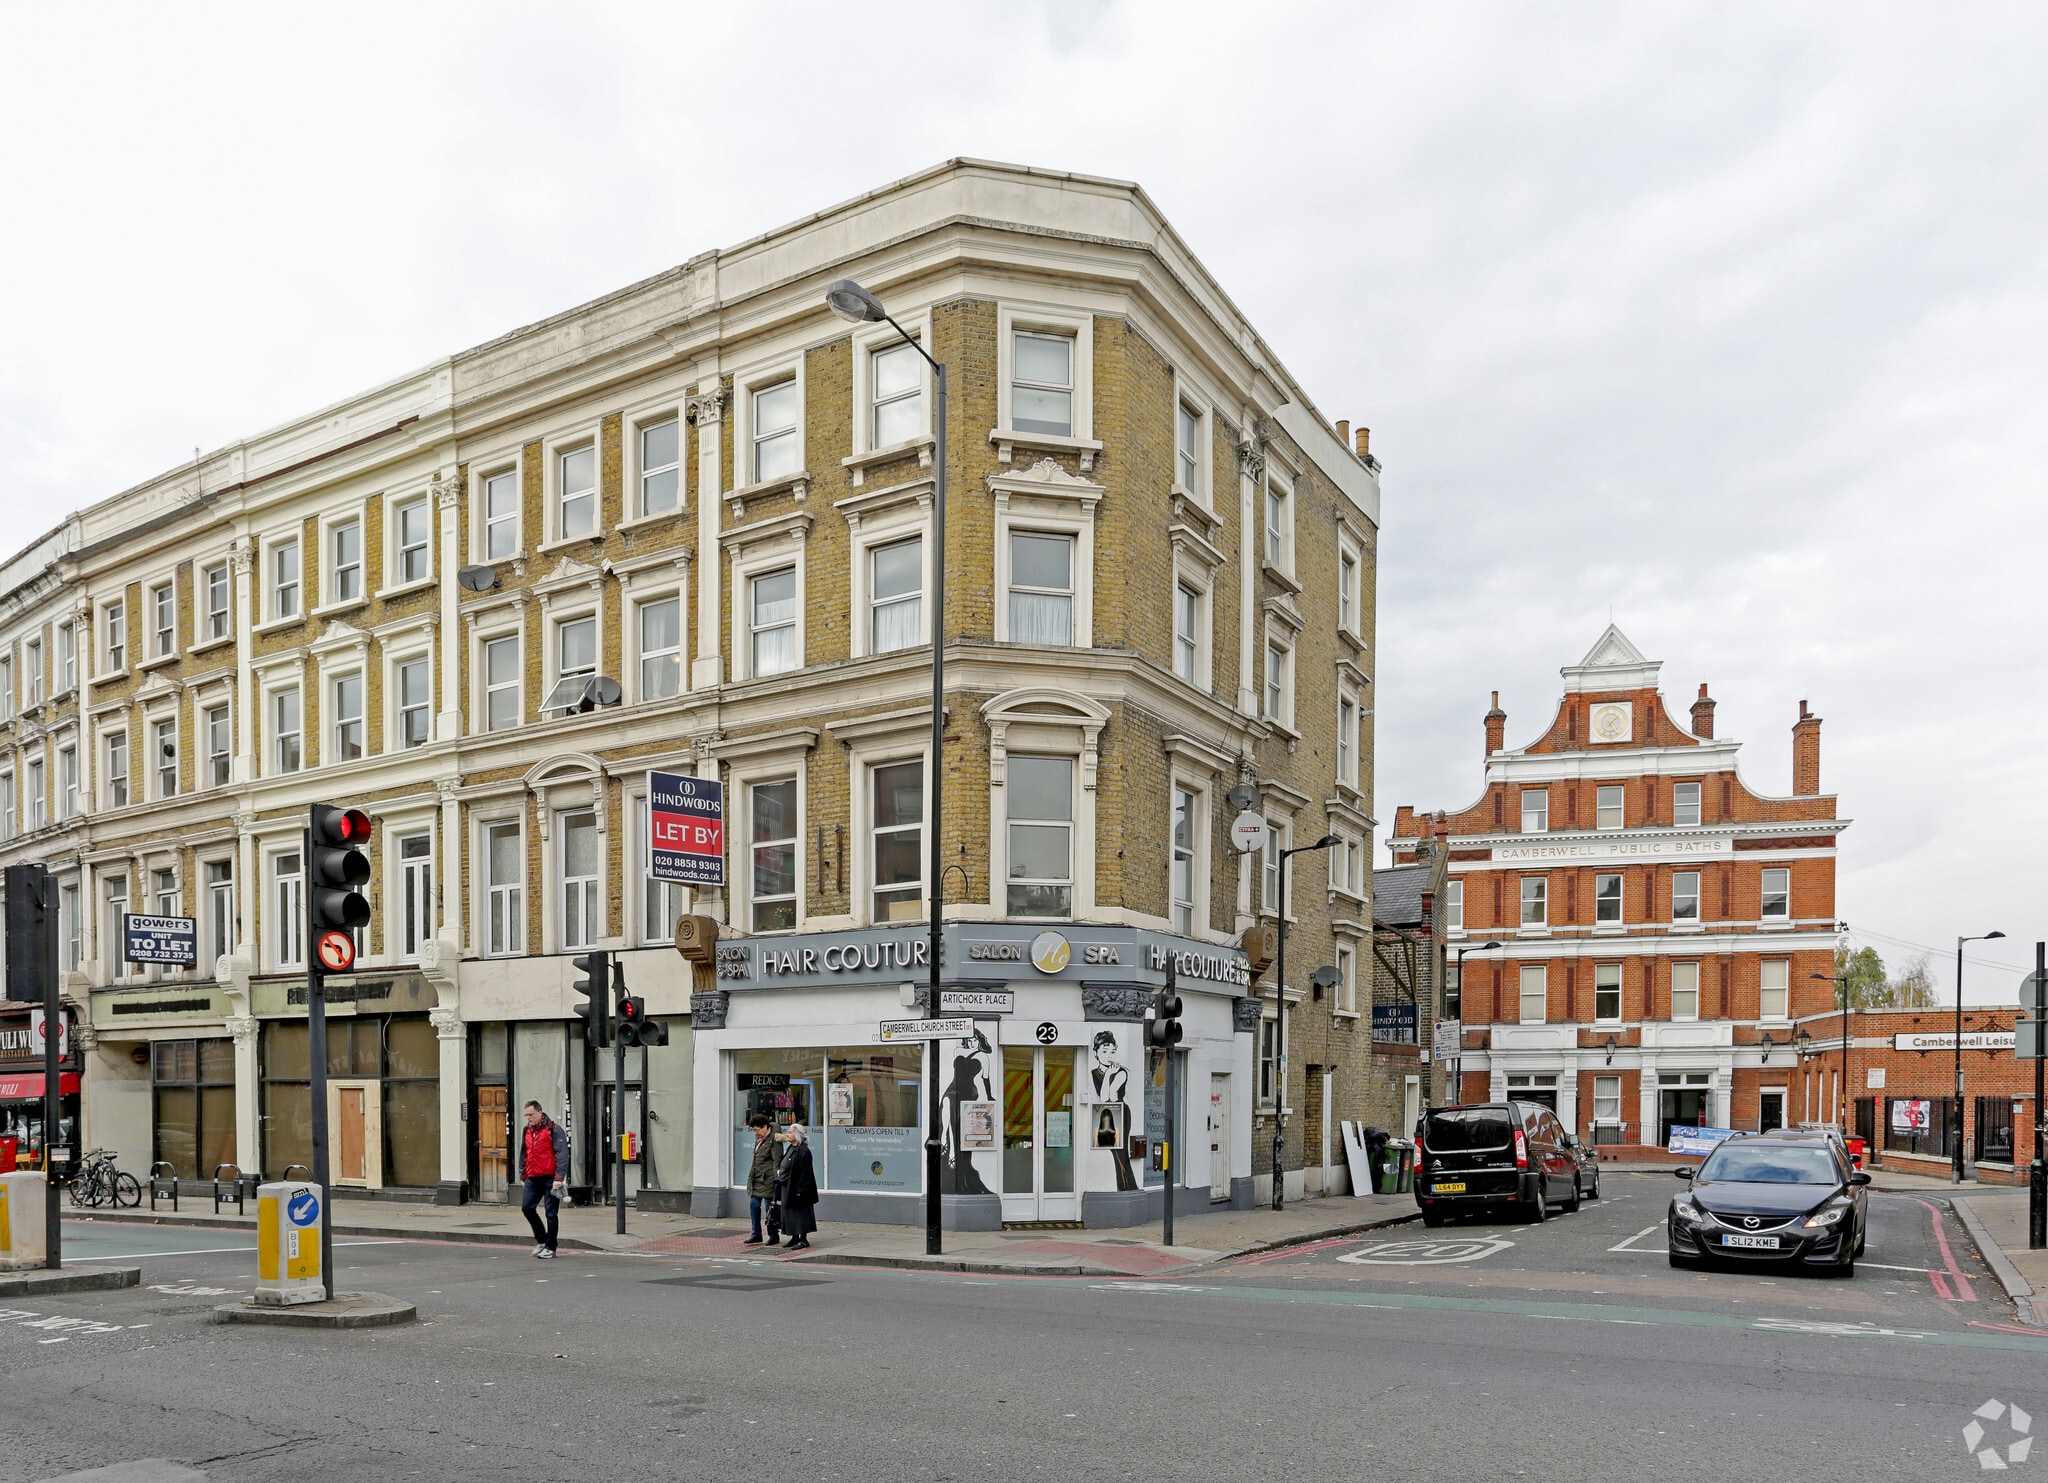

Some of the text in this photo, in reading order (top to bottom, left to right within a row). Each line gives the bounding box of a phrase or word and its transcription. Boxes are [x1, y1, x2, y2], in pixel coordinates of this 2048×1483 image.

[653, 792, 721, 812] HINDWOODS
[656, 822, 719, 845] LET BY
[1502, 841, 1722, 859] CAMBERWELL PUBLIC BATHS
[655, 856, 720, 871] 020 8858 9303
[656, 867, 720, 881] hindwoods.co.uk
[133, 918, 190, 929] gowers
[131, 938, 192, 951] TO LET
[717, 946, 748, 960] SALON
[763, 940, 945, 974] HAIR COUTUR
[970, 945, 1022, 960] SALON
[1084, 946, 1120, 963] SPA
[727, 964, 748, 978] SPA
[1182, 951, 1235, 982] COUTURE
[942, 994, 1006, 1005] ARTICHOKE PLACE
[883, 1022, 920, 1033] CAMBERWELL
[921, 1021, 945, 1032] CHURCH
[945, 1020, 966, 1031] STREET
[1038, 1026, 1056, 1040] 23
[752, 1075, 786, 1086] REDKEN
[1731, 1237, 1776, 1248] SL12 KME
[1370, 1244, 1485, 1257] 20
